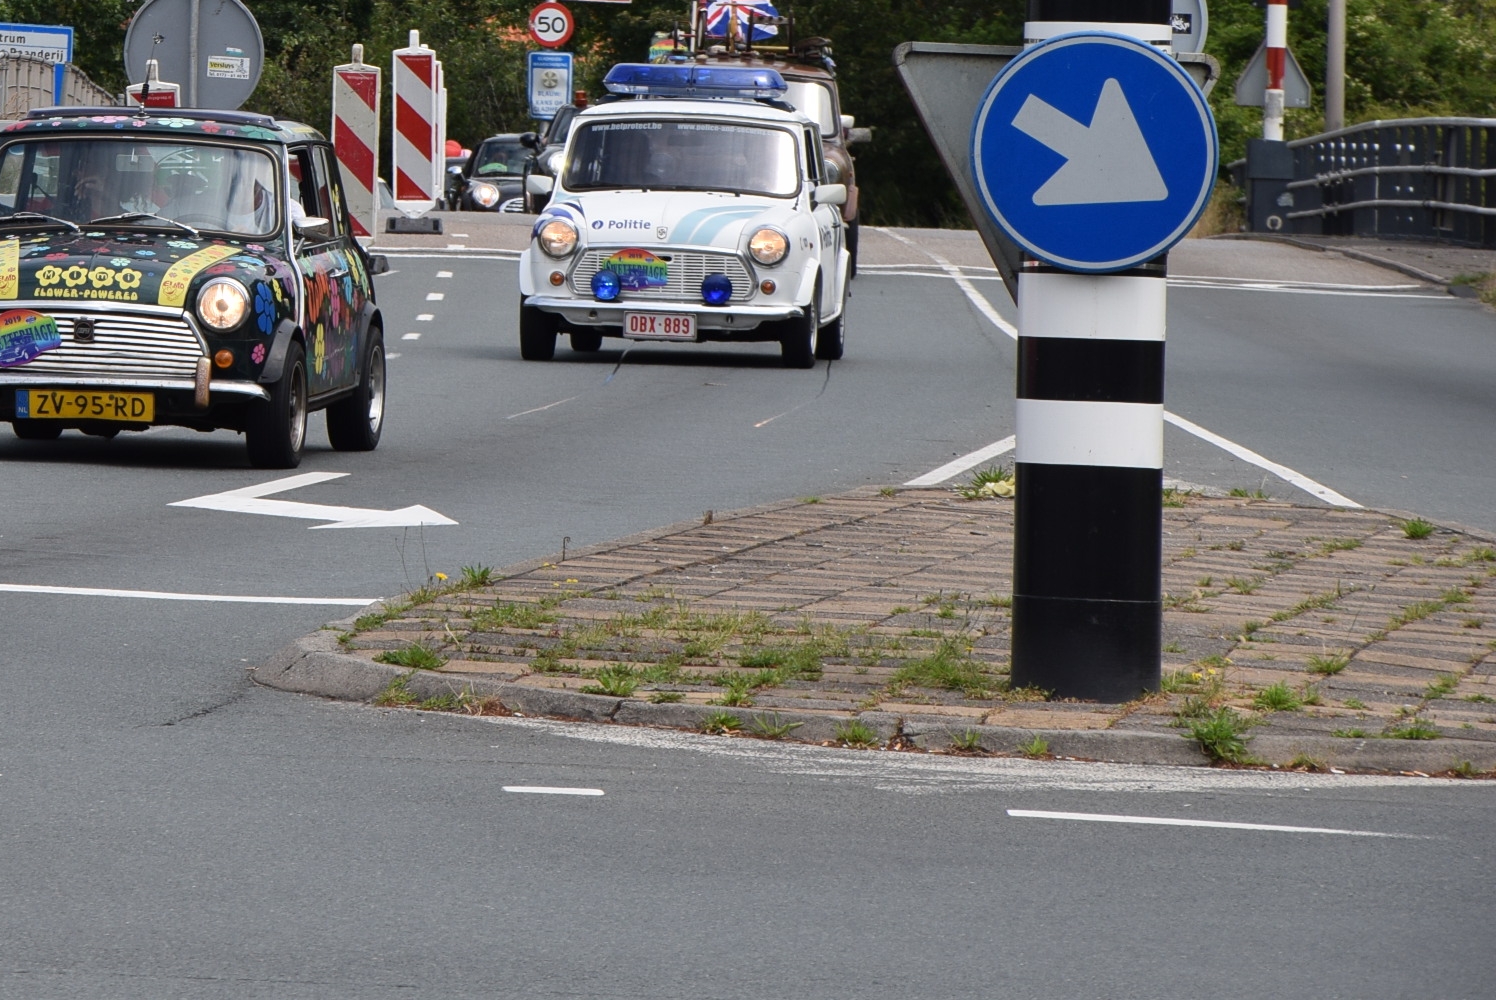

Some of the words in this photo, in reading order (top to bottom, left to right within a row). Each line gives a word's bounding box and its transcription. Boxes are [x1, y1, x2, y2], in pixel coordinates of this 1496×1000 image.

[537, 16, 565, 33] 50
[608, 220, 651, 230] Politie
[34, 288, 138, 300] FLOWER-POWERED
[4, 315, 22, 326] 2019
[36, 394, 146, 417] ZV-95-RD
